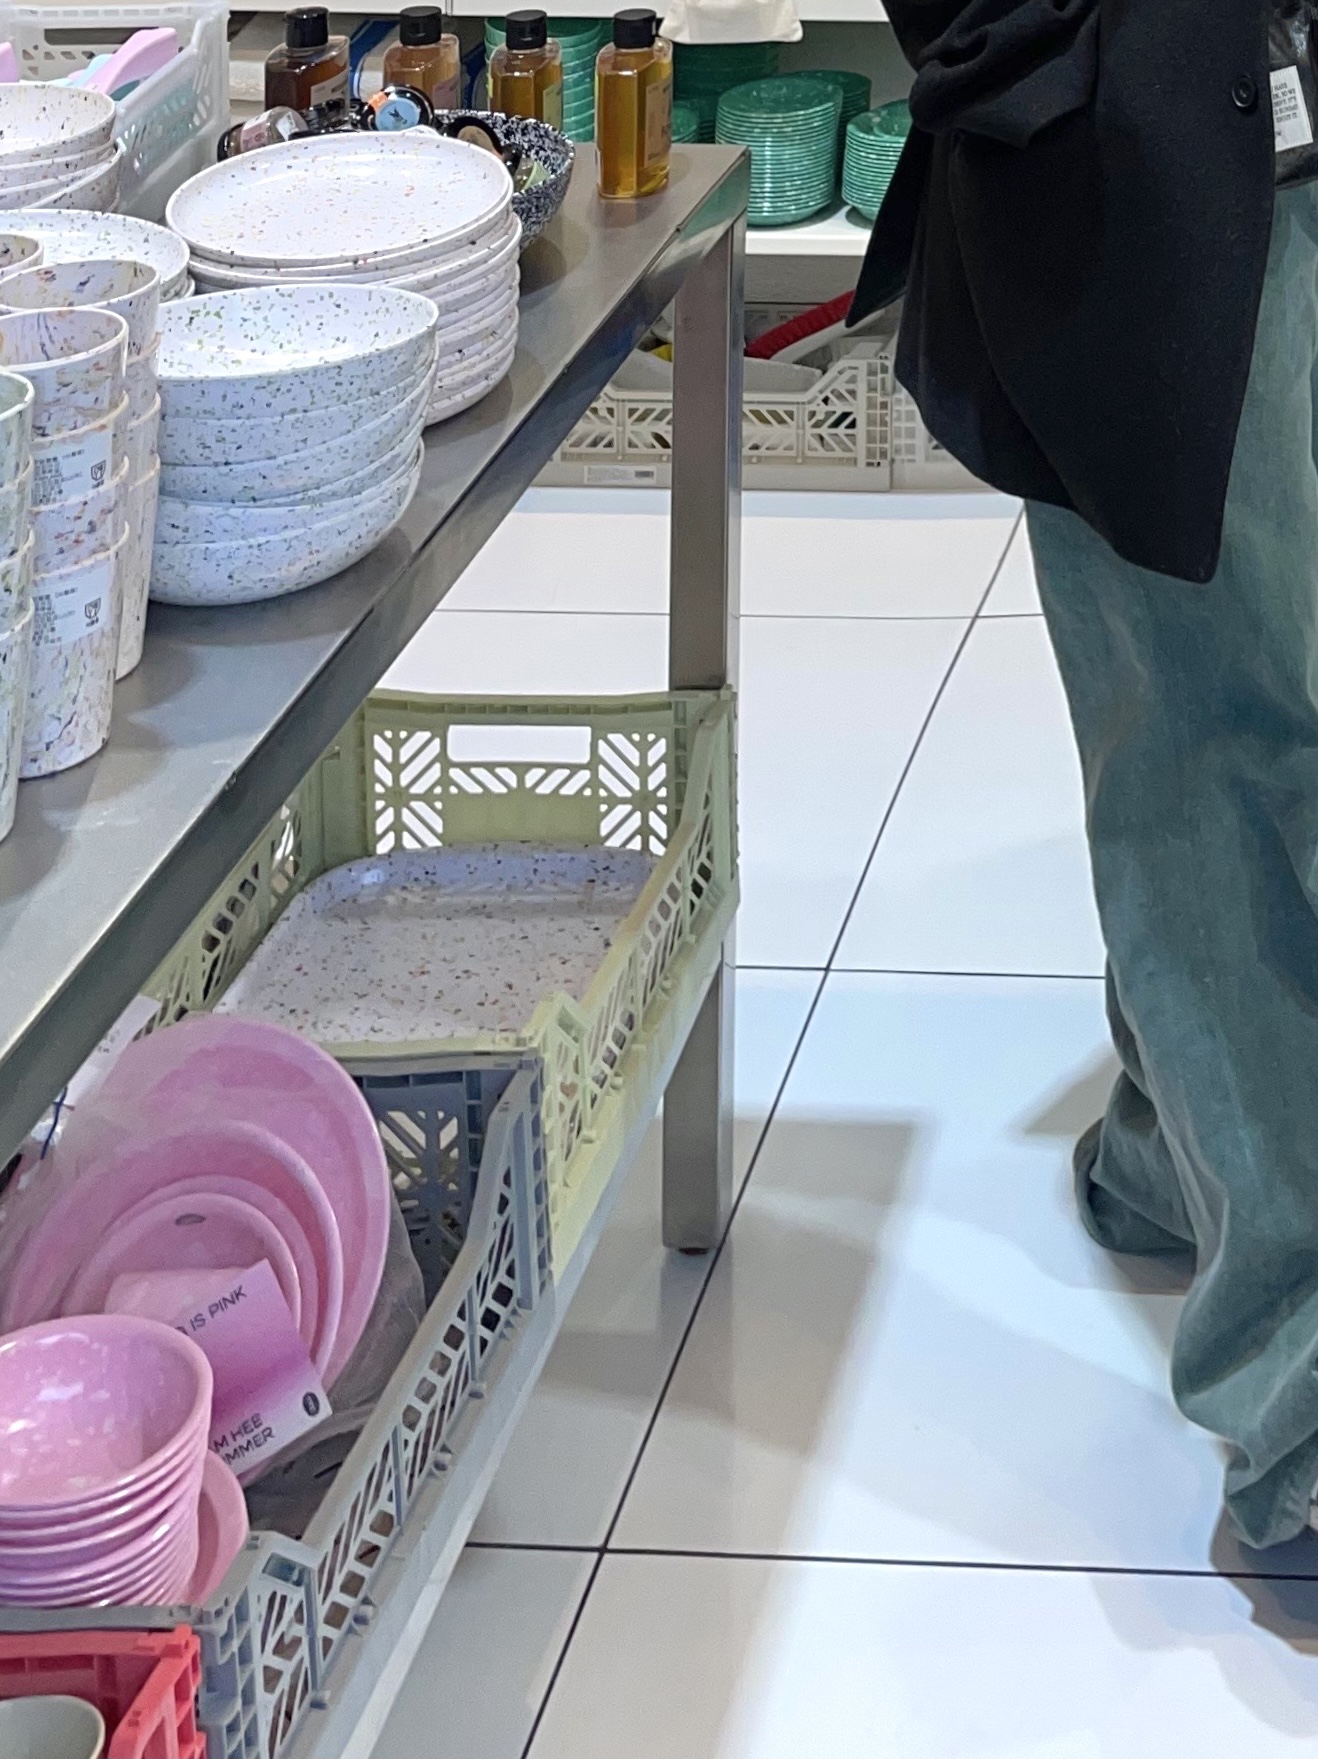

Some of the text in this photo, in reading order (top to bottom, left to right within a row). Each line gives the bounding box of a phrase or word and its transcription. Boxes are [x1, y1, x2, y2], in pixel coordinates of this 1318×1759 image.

[190, 1285, 247, 1331] IS PINK
[230, 1412, 263, 1442] HEE
